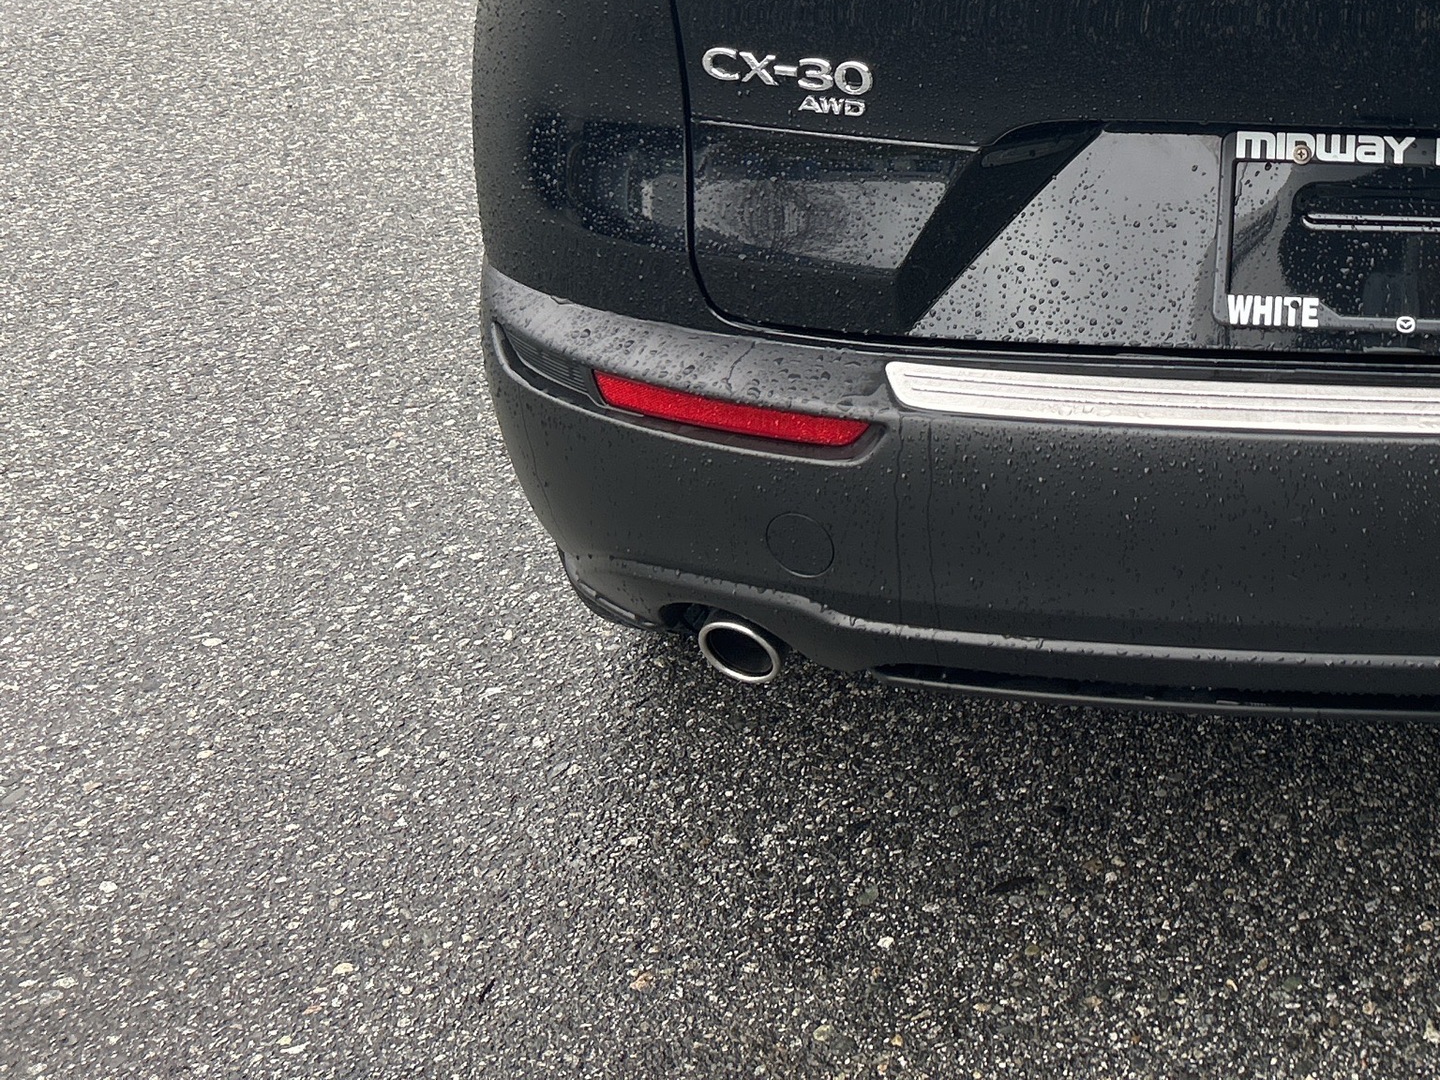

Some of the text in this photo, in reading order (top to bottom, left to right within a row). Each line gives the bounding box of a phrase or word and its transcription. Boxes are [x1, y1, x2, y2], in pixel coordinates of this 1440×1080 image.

[702, 47, 874, 96] CX-30
[798, 94, 867, 117] AWD
[1227, 294, 1320, 328] WHITE
